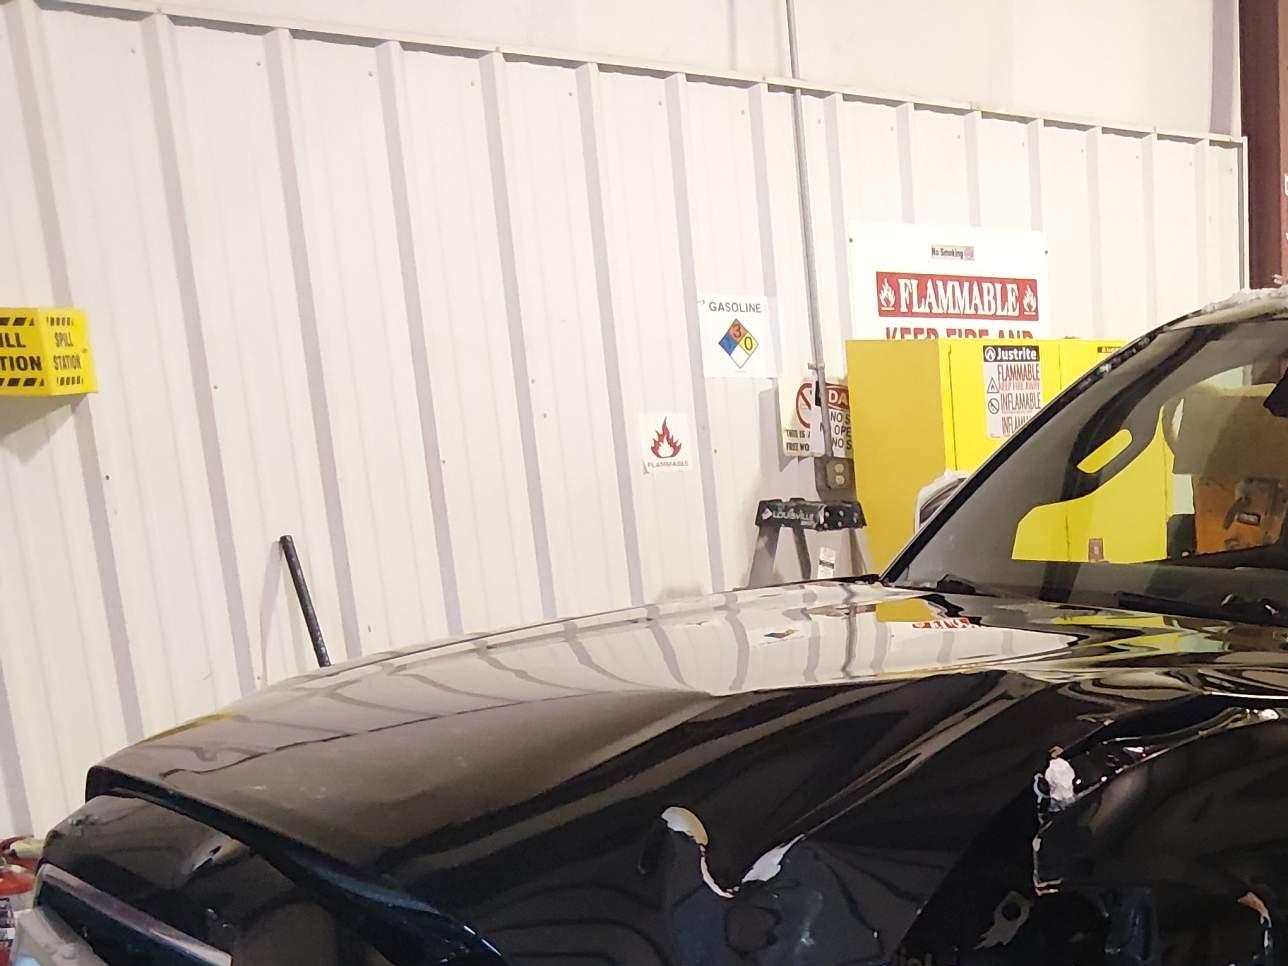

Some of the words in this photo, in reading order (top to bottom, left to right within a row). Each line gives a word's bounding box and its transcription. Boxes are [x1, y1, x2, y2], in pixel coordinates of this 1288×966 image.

[940, 247, 964, 260] Smoking
[897, 278, 1020, 317] FLAMMABLE
[708, 301, 762, 313] GASOLINE
[55, 332, 73, 347] SPILL
[997, 347, 1037, 360] Justrite
[53, 355, 81, 370] STATION
[998, 364, 1040, 381] FLAMMABLE
[1001, 393, 1041, 410] INFLAMABLE
[830, 411, 843, 423] NO
